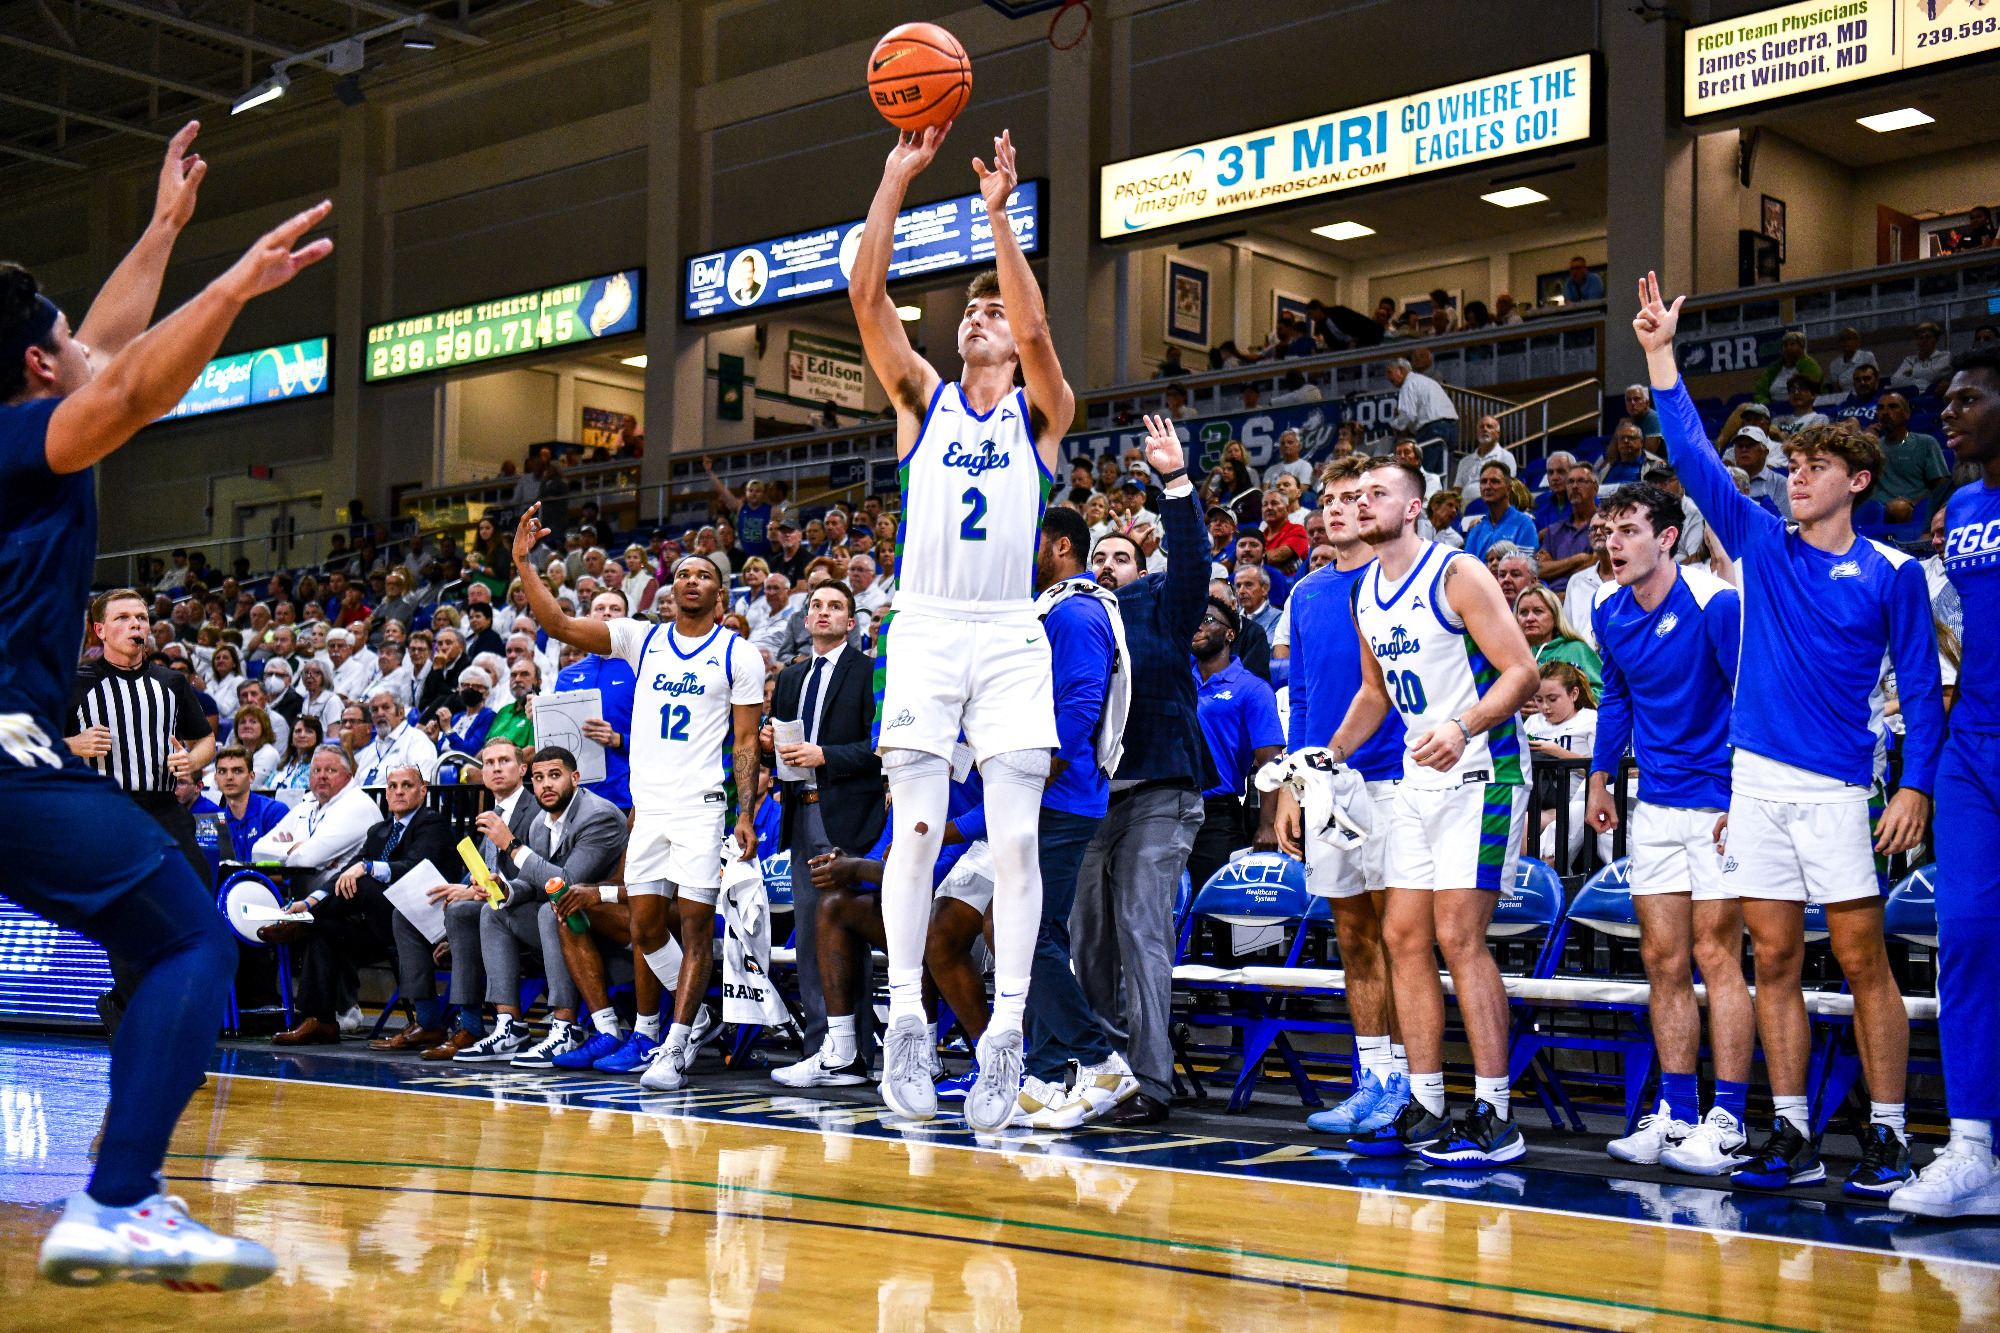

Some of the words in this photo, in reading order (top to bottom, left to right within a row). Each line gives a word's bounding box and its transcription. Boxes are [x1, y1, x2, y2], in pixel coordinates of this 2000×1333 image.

[1697, 30, 1734, 52] FGCU
[1738, 22, 1778, 42] Team
[1782, 0, 1868, 33] Physicians
[1698, 48, 1757, 76] James
[1762, 31, 1832, 61] Guerra,
[1837, 19, 1868, 44] MD
[1698, 73, 1746, 99] Brett
[1752, 54, 1831, 87] Wilhoit,
[1836, 44, 1868, 69] MD
[1401, 101, 1431, 133] GO
[1438, 80, 1523, 125] WHERE
[1529, 67, 1576, 105] THE
[1216, 136, 1276, 187] 3T
[1293, 110, 1388, 172] MRI
[1415, 119, 1504, 165] EAGLES
[1516, 108, 1558, 144] GO!
[1114, 169, 1193, 200] PROSCAN
[1134, 187, 1208, 214] imaging
[368, 323, 394, 344] GET
[397, 316, 432, 338] YOUR
[477, 294, 538, 319] TICKETS
[542, 285, 582, 308] NOW!
[373, 309, 574, 377] 239.590.7145
[1710, 335, 1758, 373] RR
[204, 357, 254, 393] Eagles!
[807, 356, 863, 384] Edison
[942, 438, 1010, 477] Eagles
[960, 486, 987, 541] 2
[1371, 624, 1420, 661] Eagles
[652, 672, 706, 697] Eagles
[1386, 669, 1428, 715] 20
[660, 703, 692, 742] 12
[1217, 861, 1289, 883] NCH
[1245, 888, 1278, 896] Healthcare
[1254, 895, 1277, 903] System
[1497, 901, 1522, 909] System
[1803, 906, 1820, 915] tem
